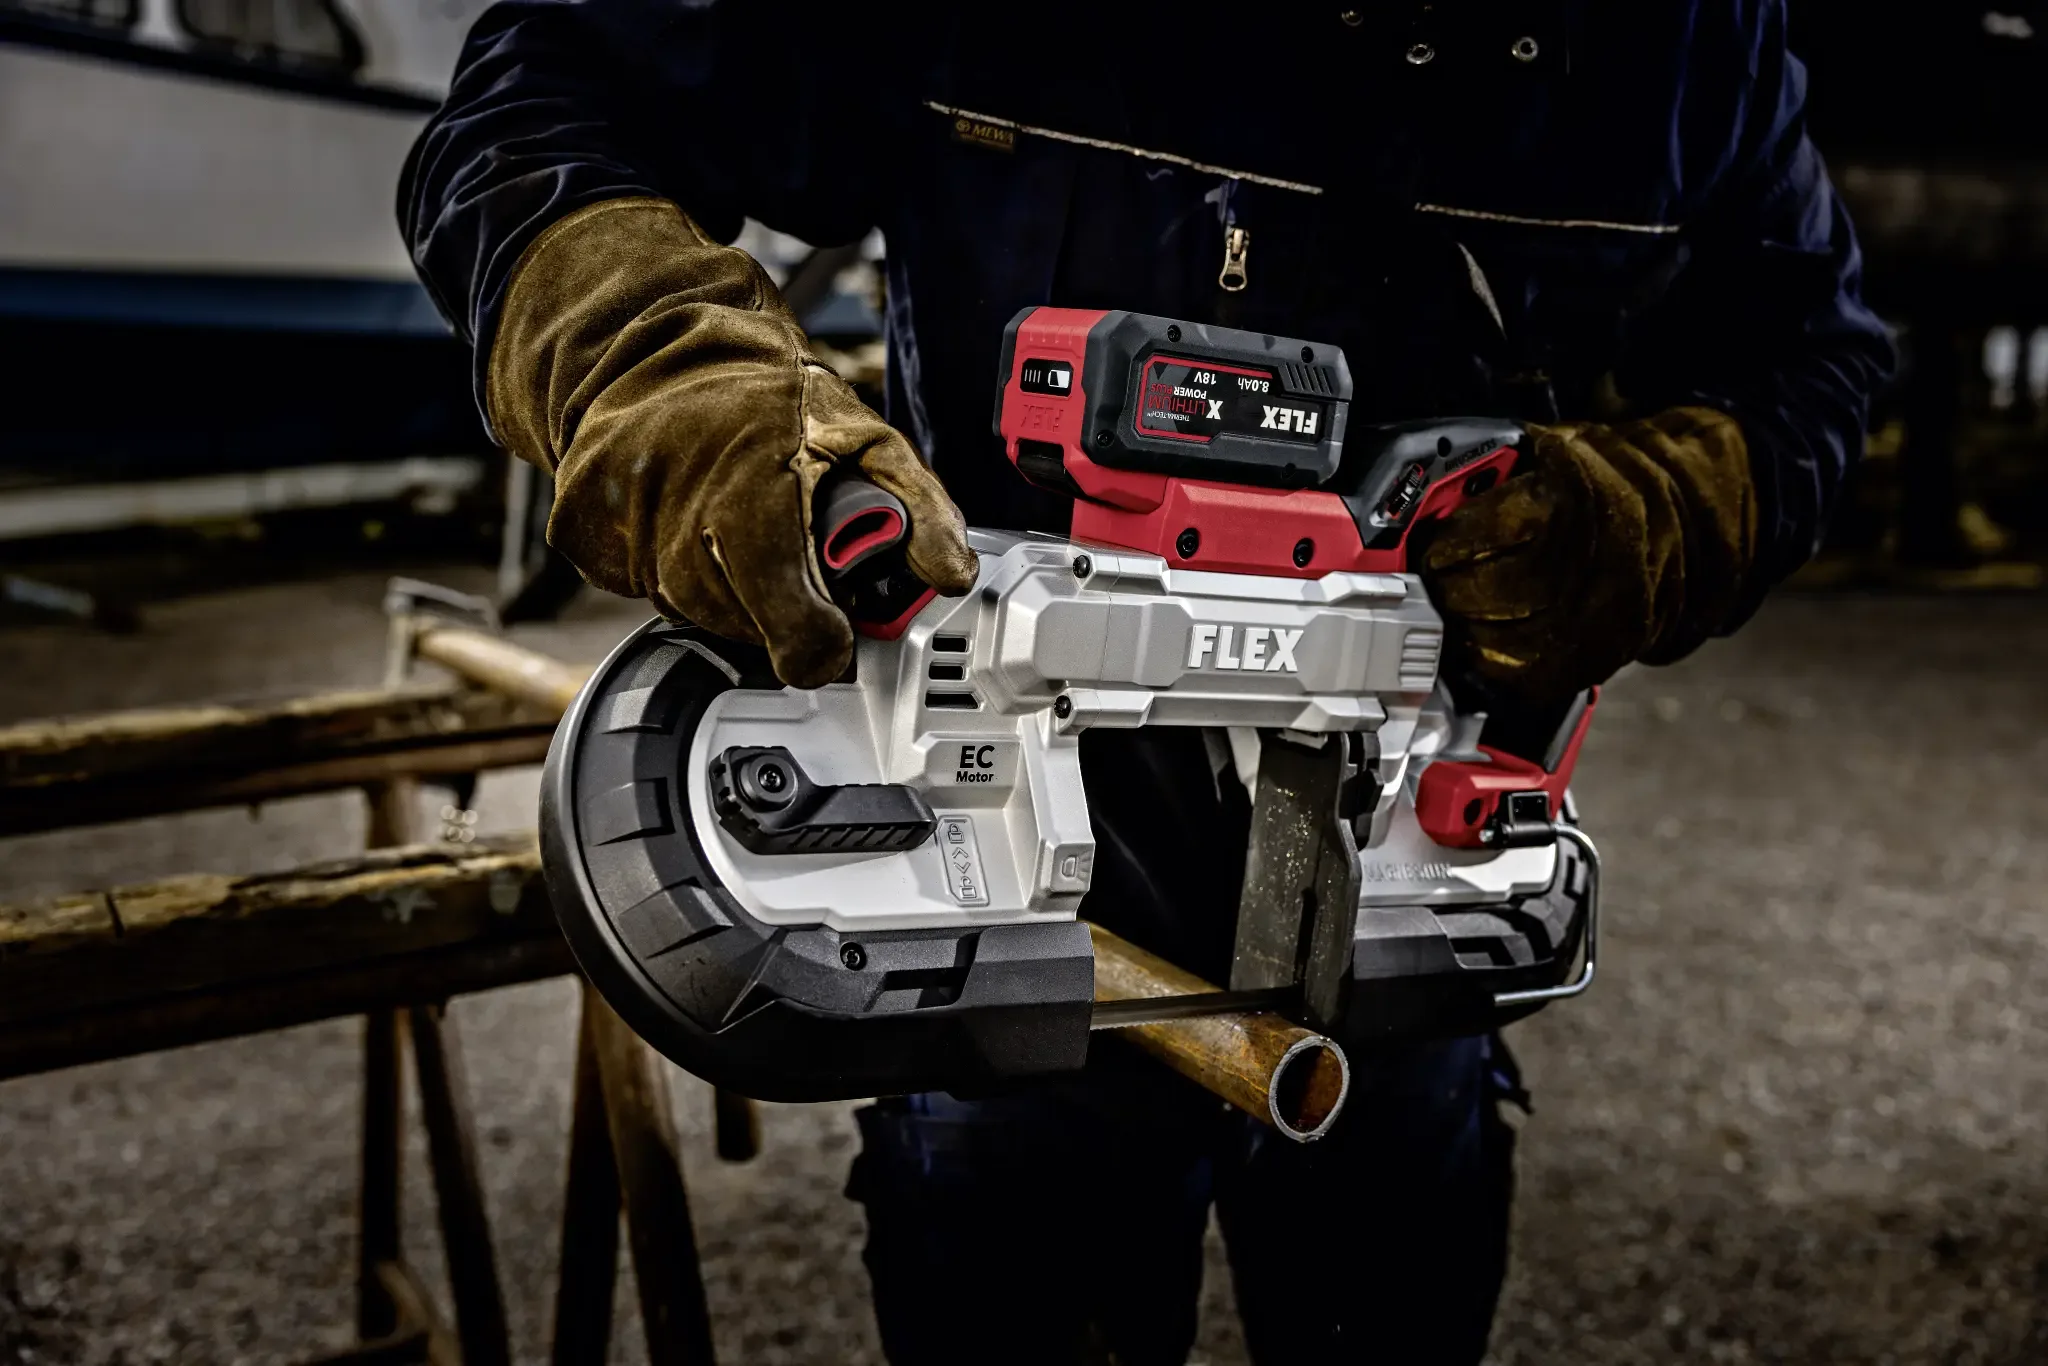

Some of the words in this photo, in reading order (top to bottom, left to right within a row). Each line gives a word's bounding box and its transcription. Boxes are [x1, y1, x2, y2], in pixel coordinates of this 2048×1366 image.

[972, 124, 1015, 144] MEWA
[1193, 371, 1217, 385] 18V
[1237, 377, 1270, 393] 8.0Ah
[1150, 384, 1173, 394] PLUS
[1173, 386, 1207, 399] POWER
[1020, 404, 1064, 432] FLEX
[1260, 404, 1319, 435] FLEX
[1187, 623, 1305, 673] FLEX
[959, 745, 996, 769] EC
[955, 770, 995, 783] Motor
